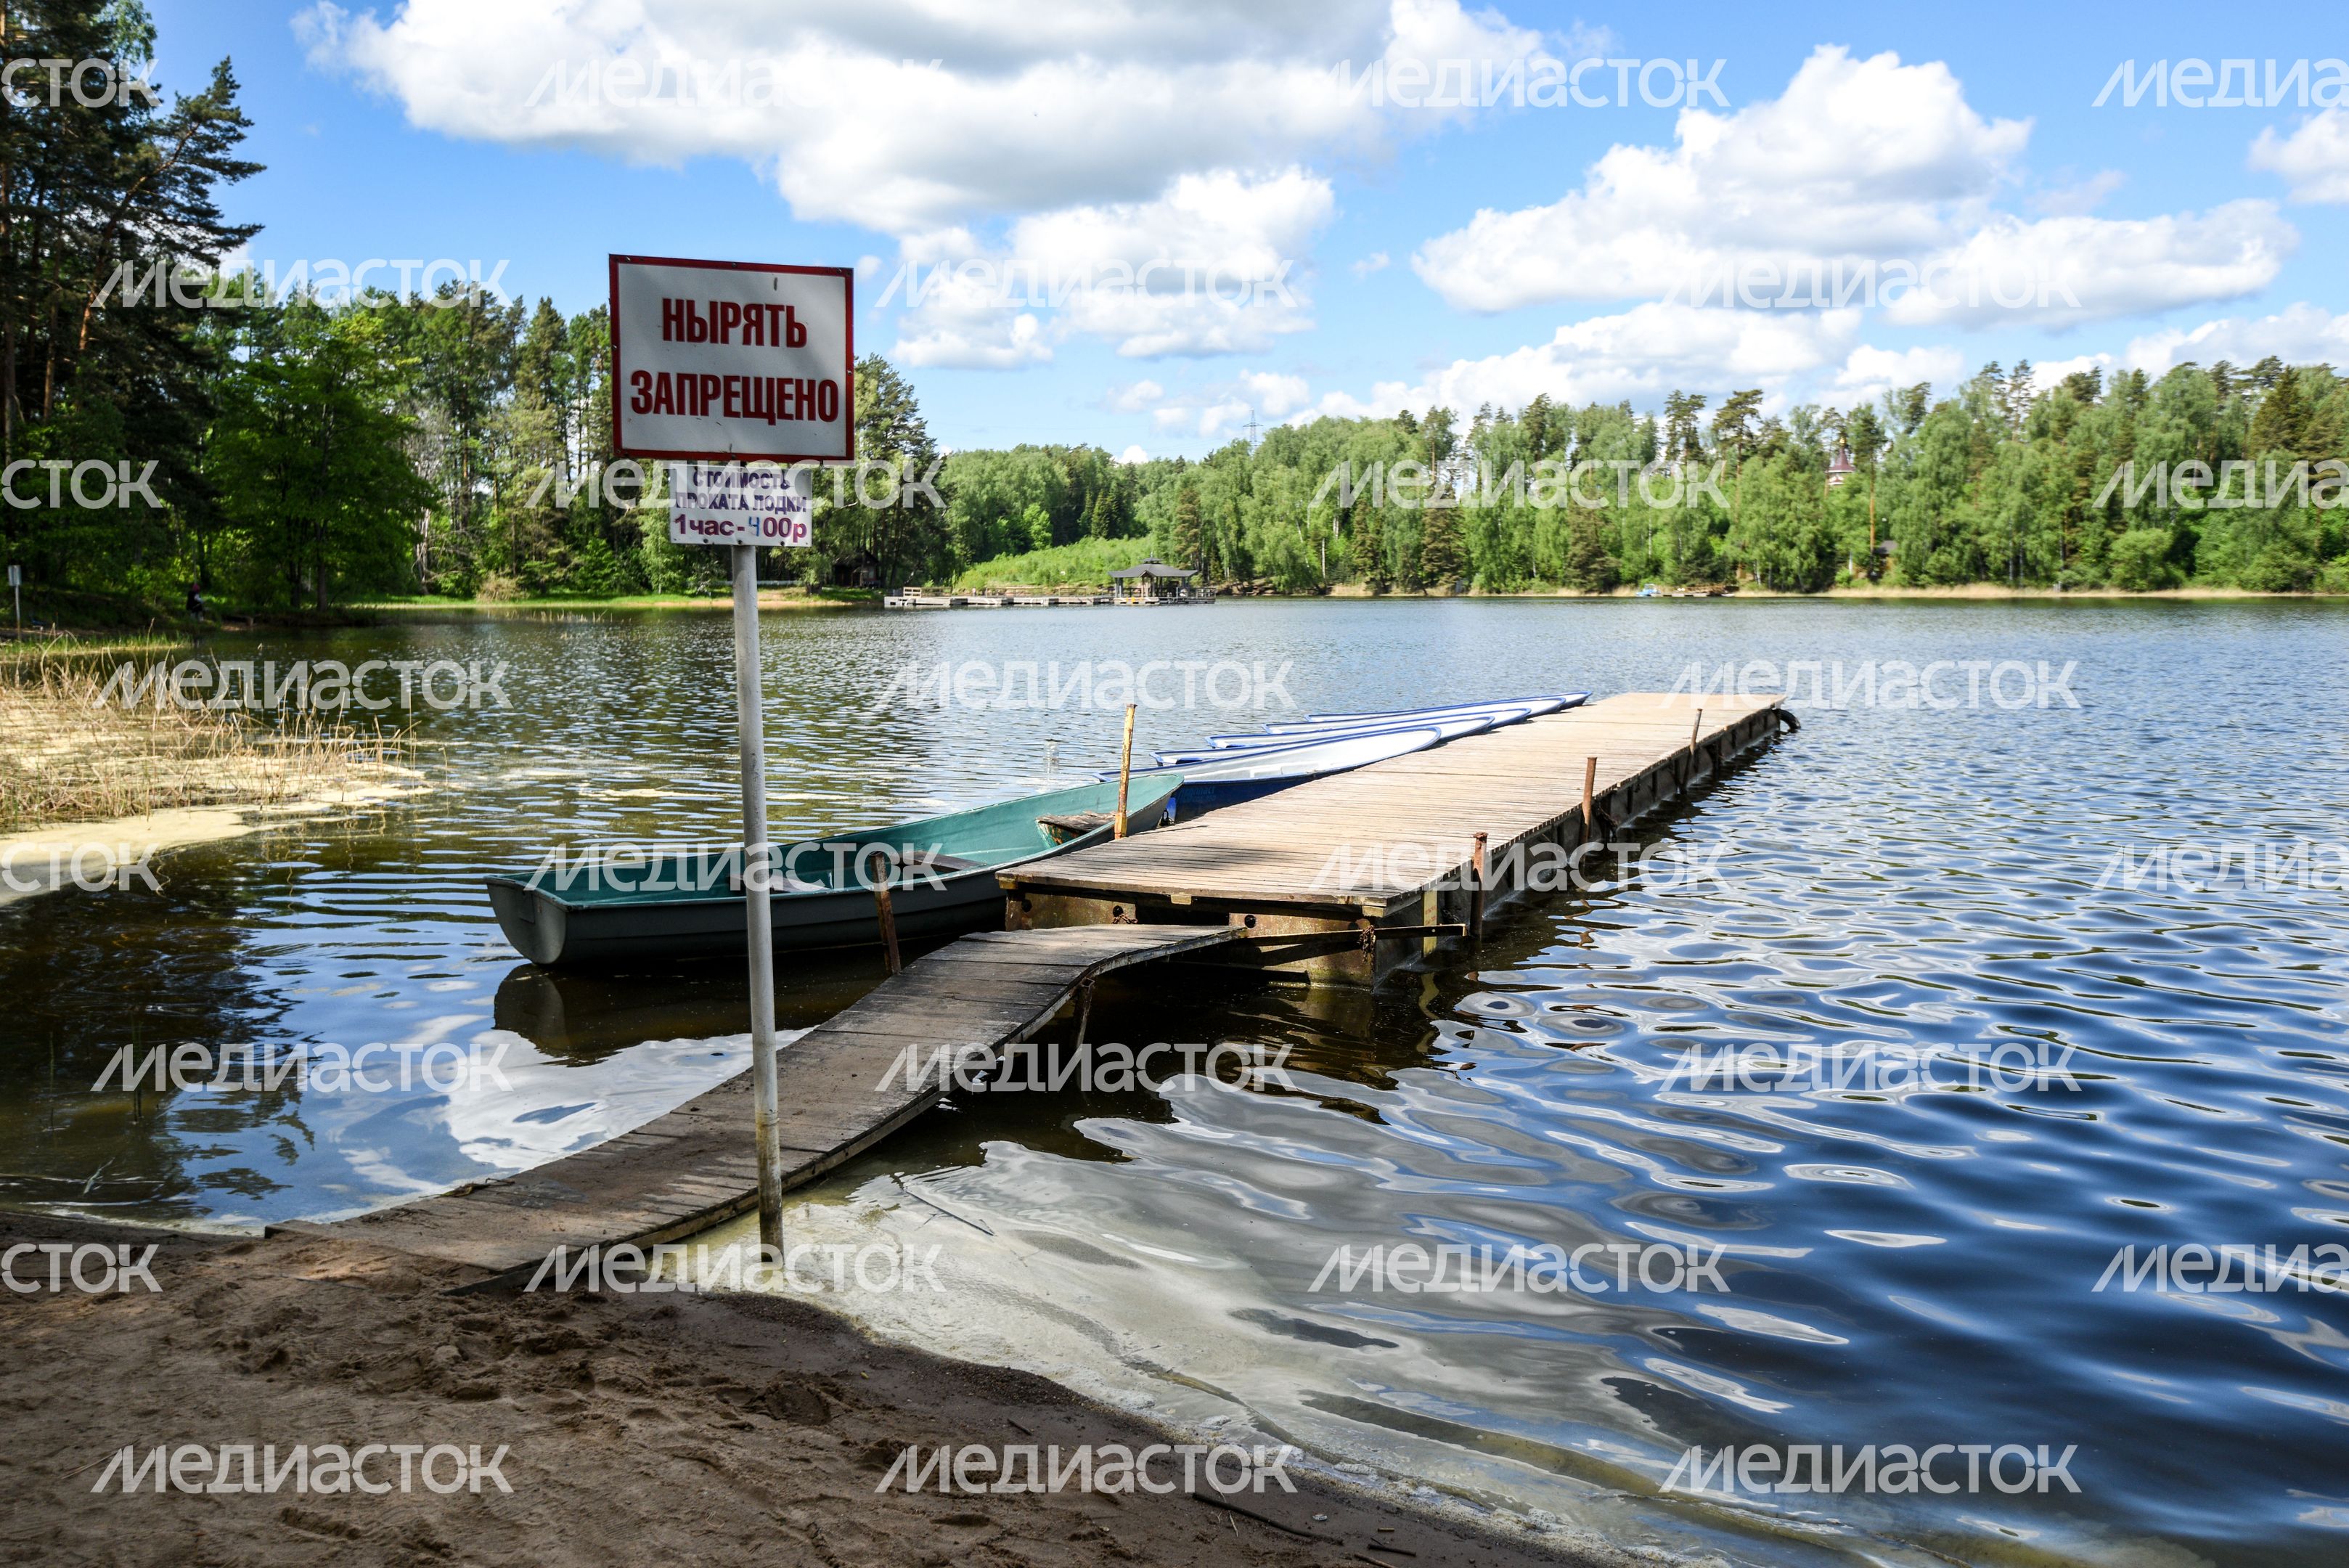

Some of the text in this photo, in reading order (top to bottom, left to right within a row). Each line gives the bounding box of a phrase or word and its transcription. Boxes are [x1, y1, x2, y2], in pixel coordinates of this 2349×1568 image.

[662, 298, 808, 348] НЫРЯТЬ
[630, 370, 839, 426] ЗАПРЕЩЕНО
[693, 470, 791, 490] СТОИМОСТЬ
[676, 492, 807, 515] ПРОКАТА ЛОДКИ
